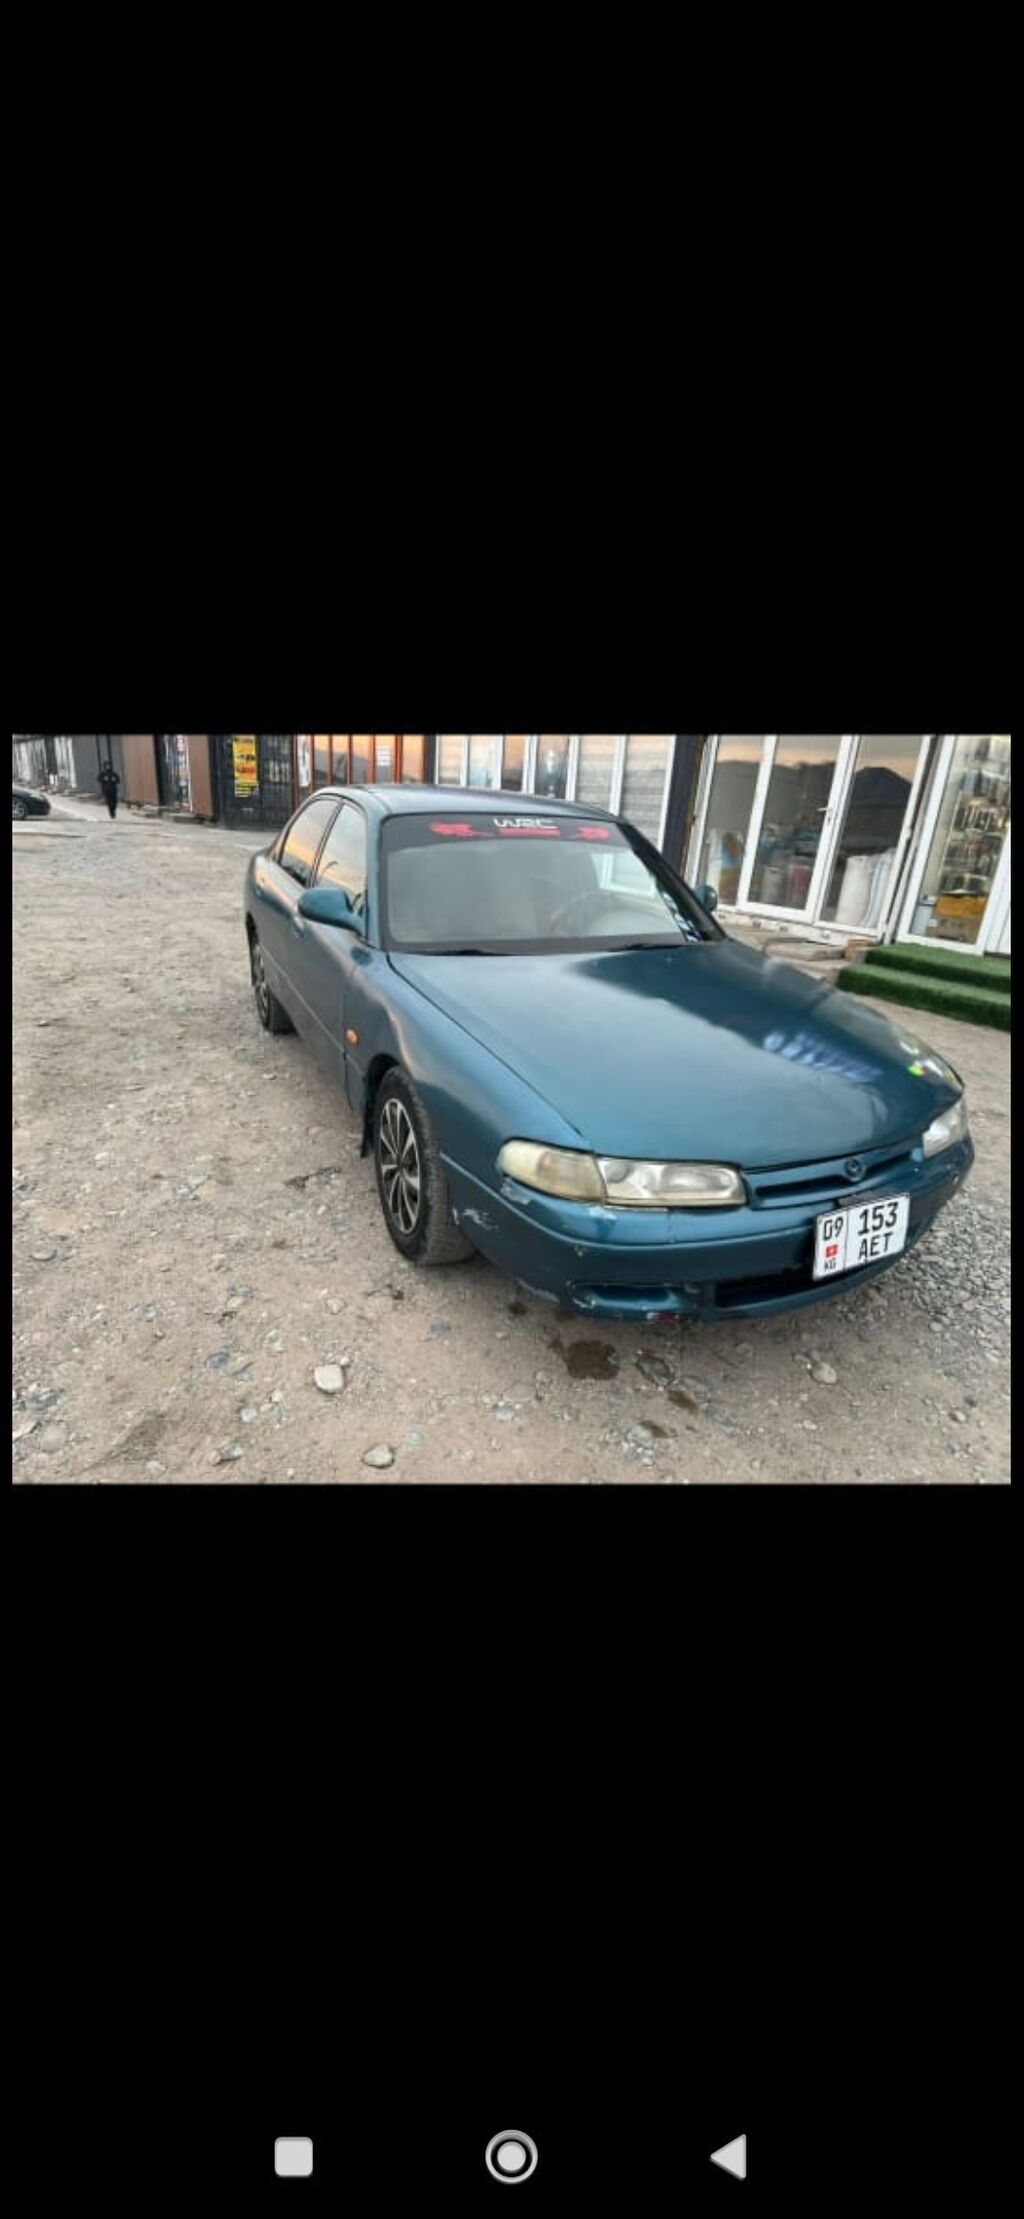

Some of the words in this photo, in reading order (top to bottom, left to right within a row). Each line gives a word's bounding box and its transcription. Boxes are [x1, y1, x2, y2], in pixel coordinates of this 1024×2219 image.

[493, 818, 558, 829] WRC
[824, 1217, 844, 1241] 09
[857, 1202, 899, 1236] 153
[858, 1232, 893, 1260] AET
